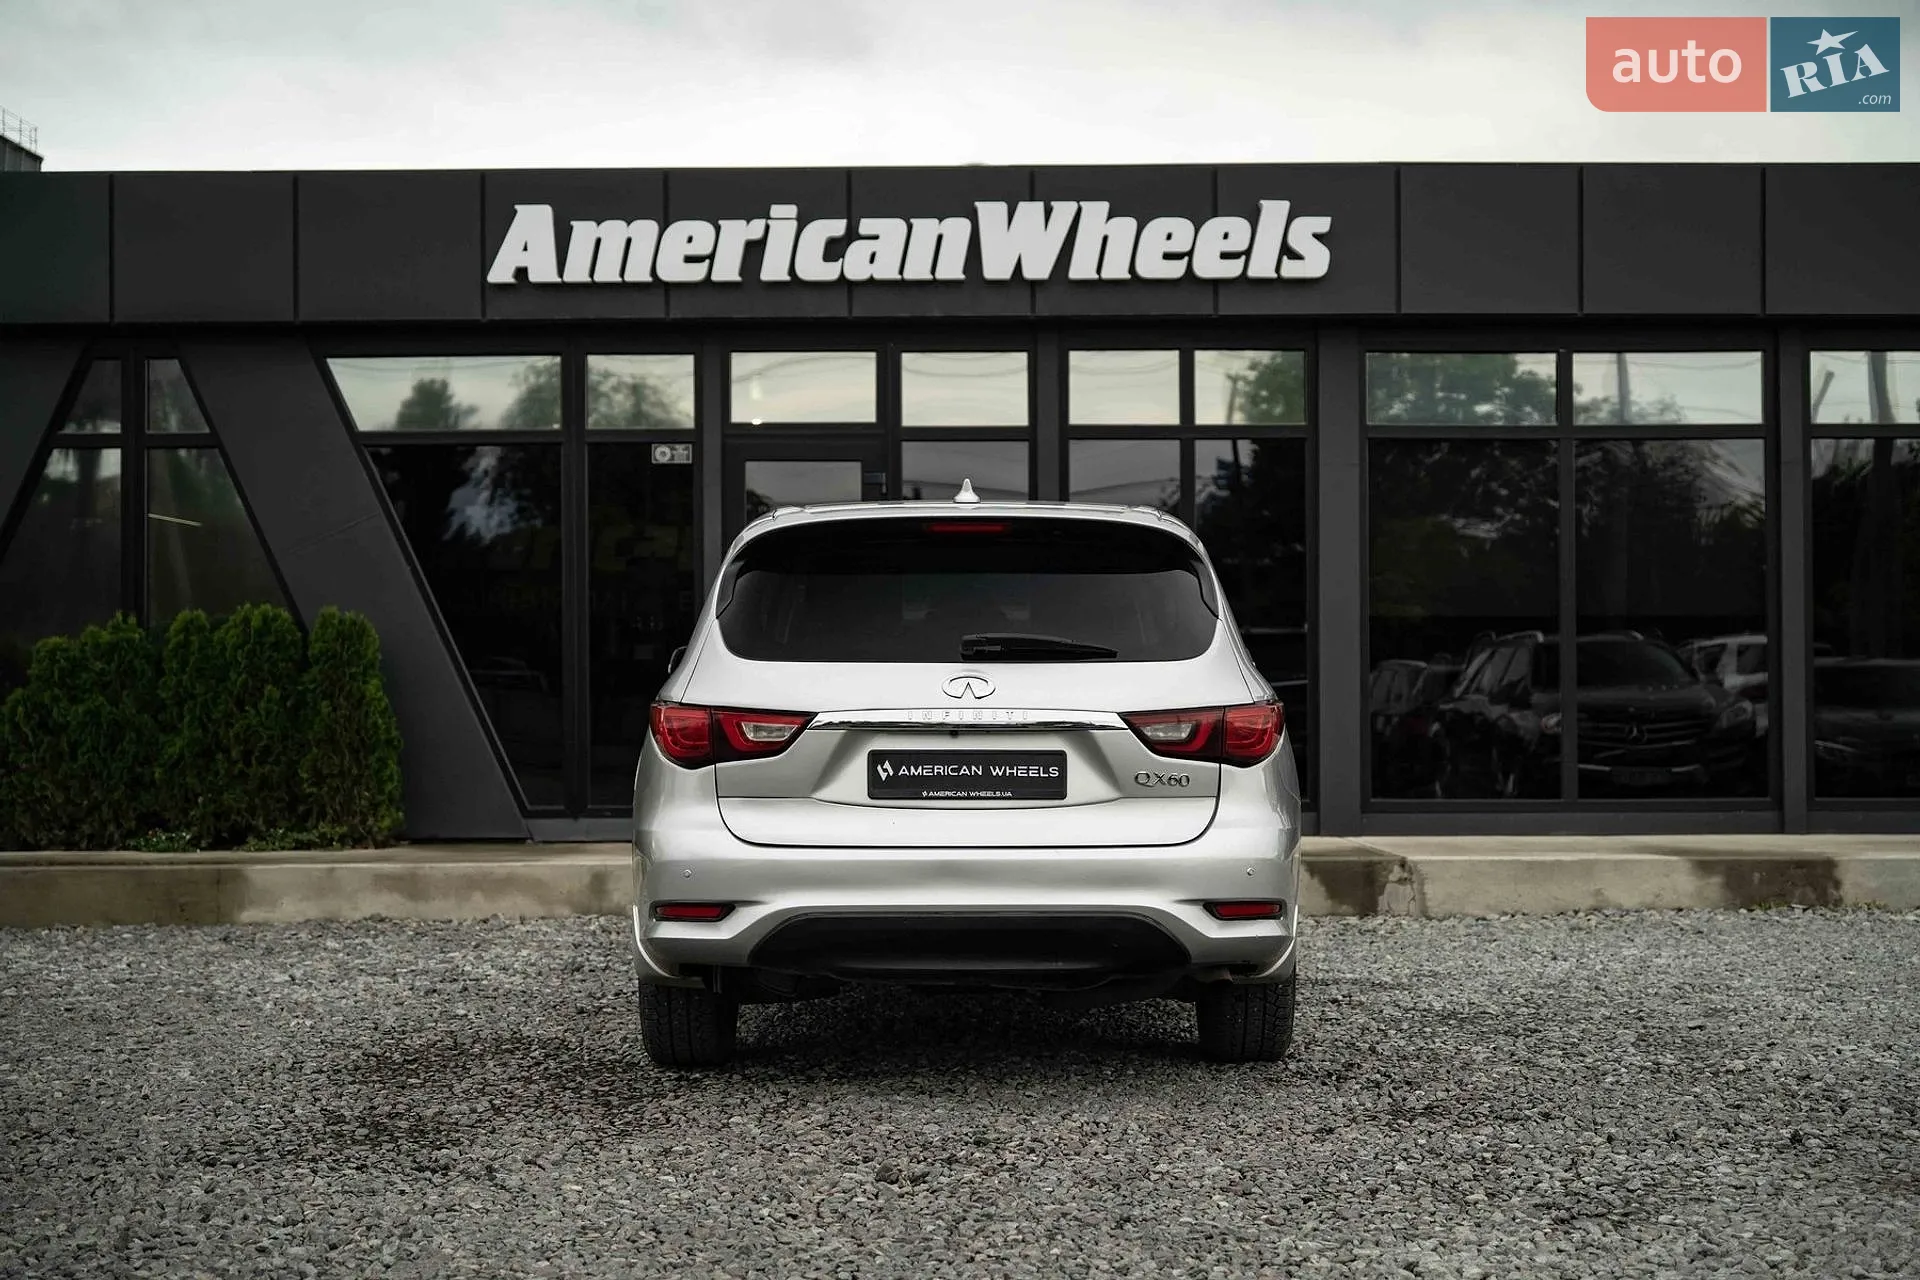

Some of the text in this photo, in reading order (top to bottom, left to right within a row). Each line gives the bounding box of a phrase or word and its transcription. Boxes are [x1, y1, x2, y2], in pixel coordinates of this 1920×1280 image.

[906, 710, 1030, 721] INFINITI
[898, 764, 1060, 778] AMERICAN WHEELS
[1133, 770, 1191, 788] QX60
[928, 790, 1013, 798] AMERICAN WHEELS.UA
